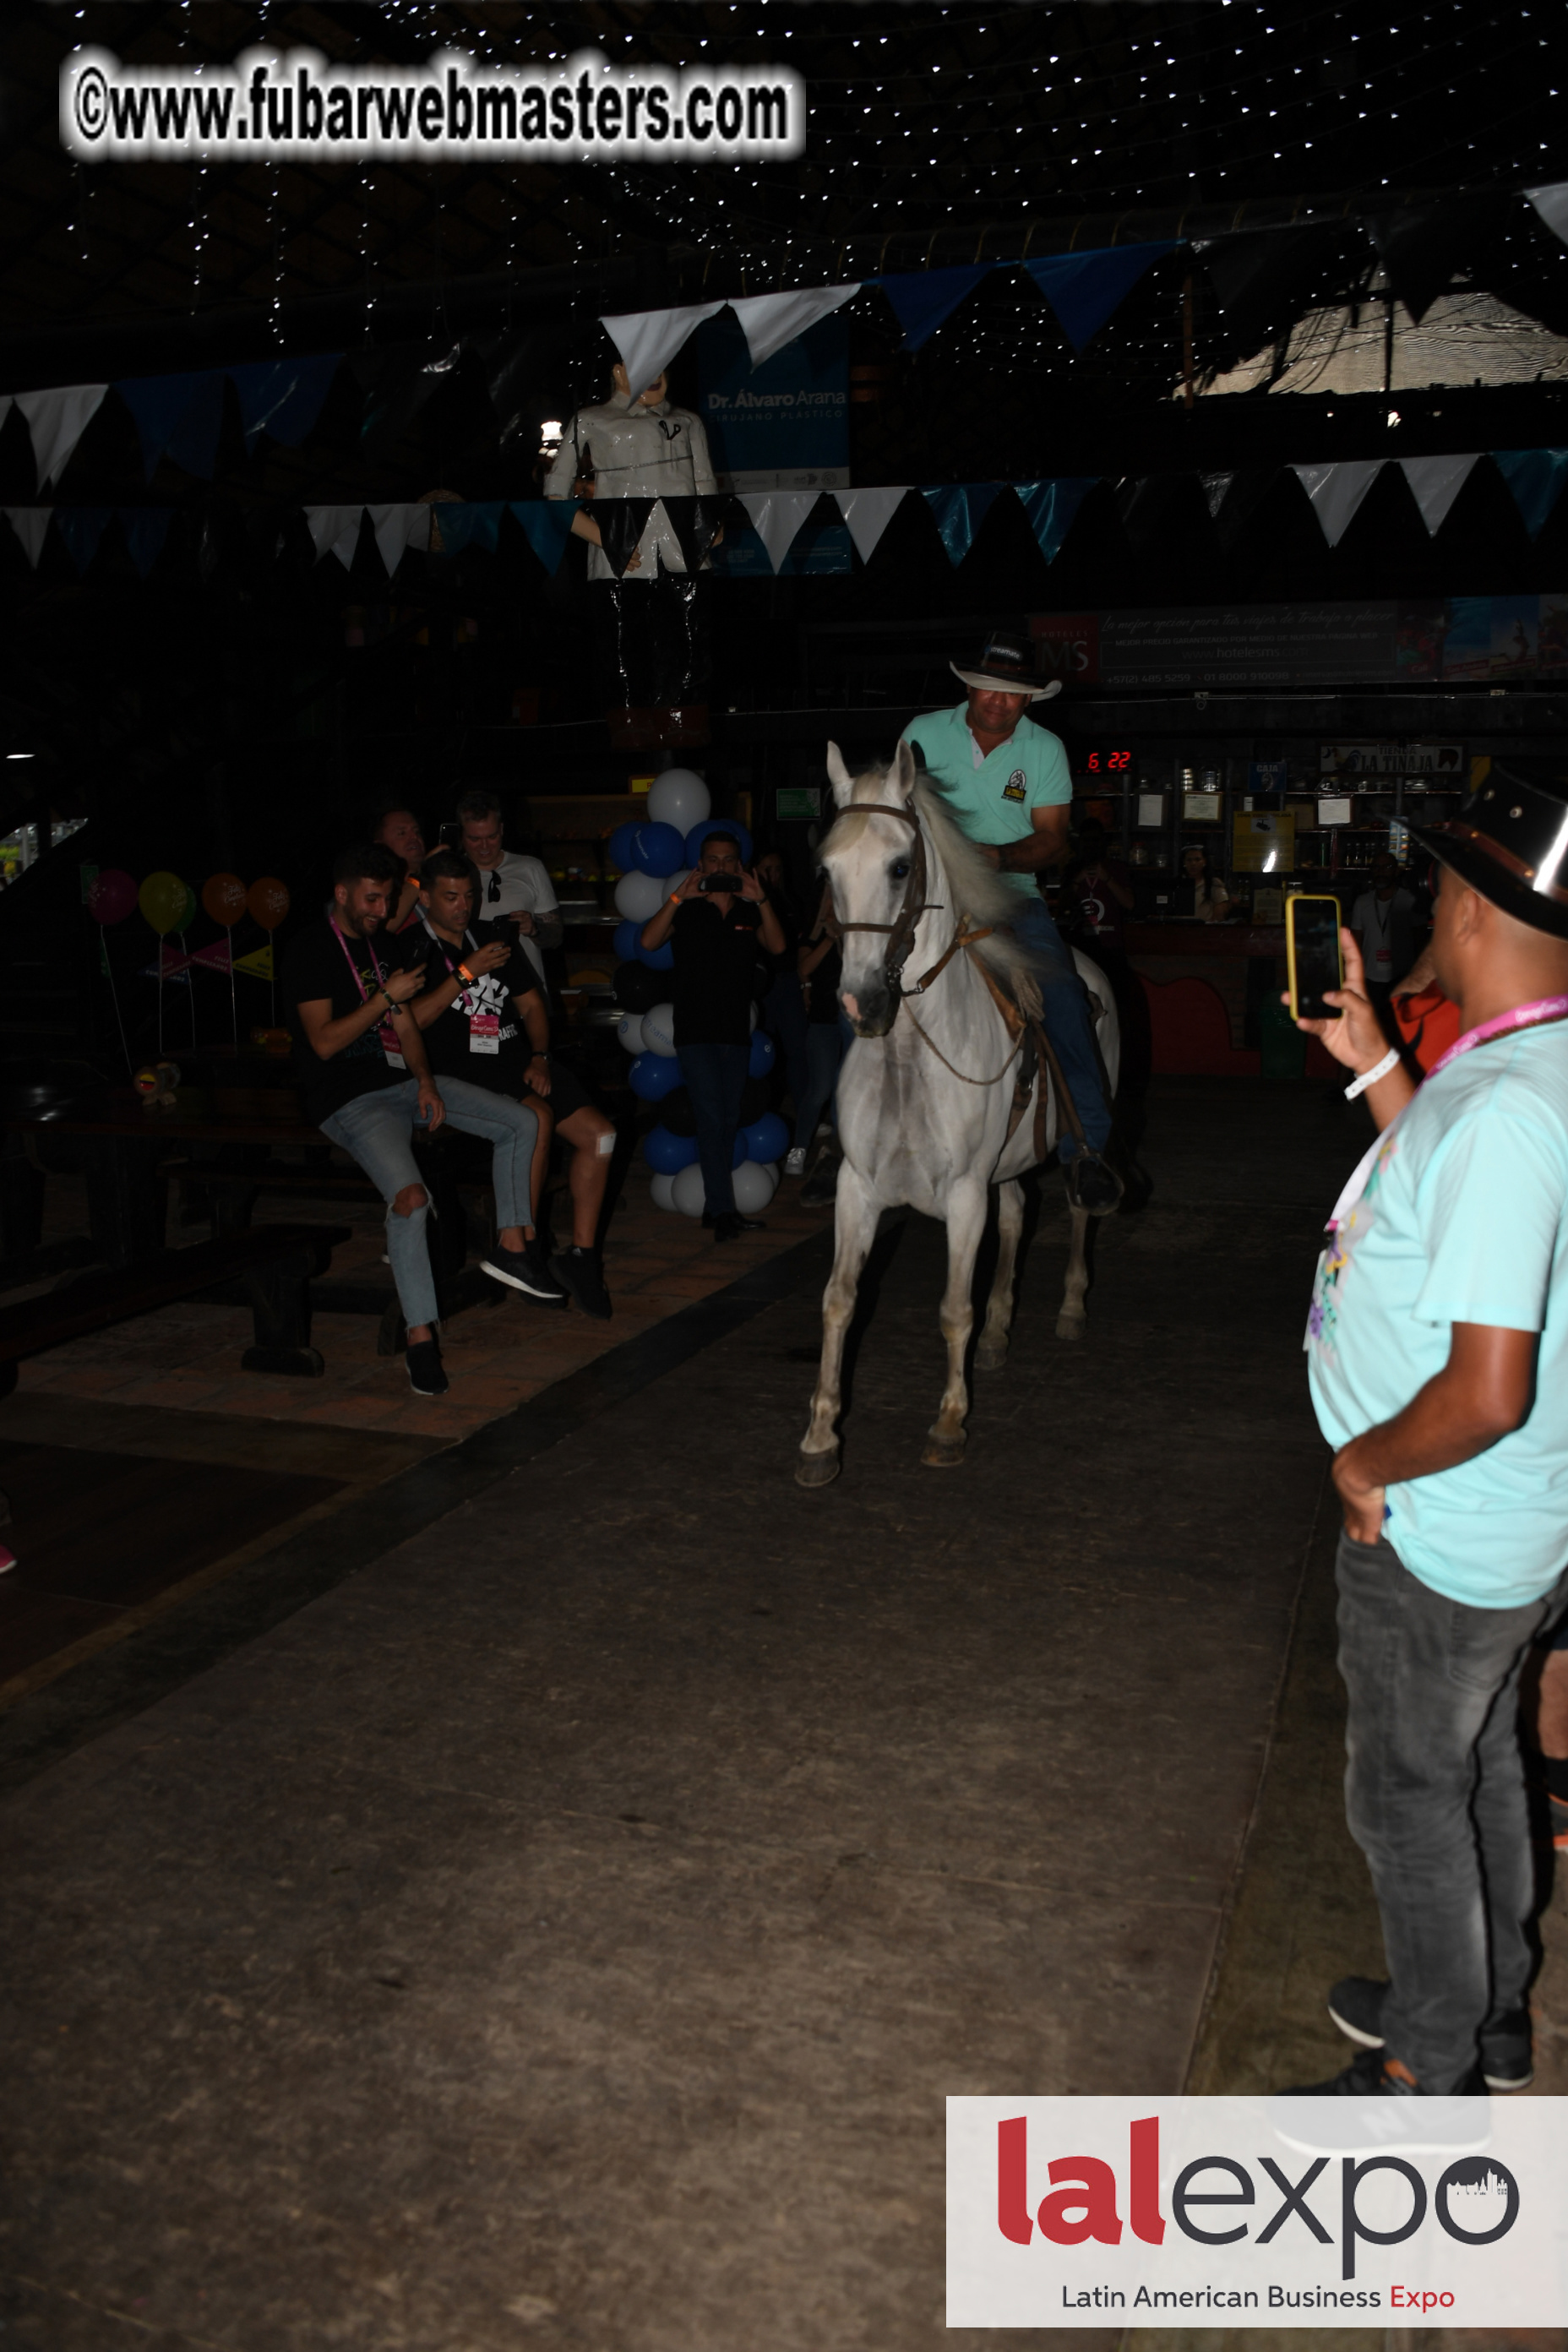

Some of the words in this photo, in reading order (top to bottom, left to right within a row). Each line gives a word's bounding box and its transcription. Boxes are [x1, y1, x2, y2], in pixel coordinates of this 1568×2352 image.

[708, 393, 732, 410] Dr.
[734, 389, 794, 408] Álvaro
[795, 389, 847, 406] Arana
[1118, 618, 1151, 634] mejor
[1190, 618, 1218, 633] para
[1280, 612, 1295, 623] de
[1351, 608, 1394, 628] placer
[1041, 629, 1089, 638] HOTELES
[1173, 636, 1228, 645] GARANTIZADO
[1290, 633, 1326, 641] NUESTRA
[1041, 640, 1089, 672] MS
[1107, 675, 1138, 684] +57(2)
[1141, 674, 1162, 683] 485
[1165, 673, 1191, 683] 5259
[1219, 672, 1247, 681] 8000
[1256, 764, 1278, 773] CAJA
[1361, 755, 1378, 771] LA
[1384, 755, 1434, 771] TINAJA
